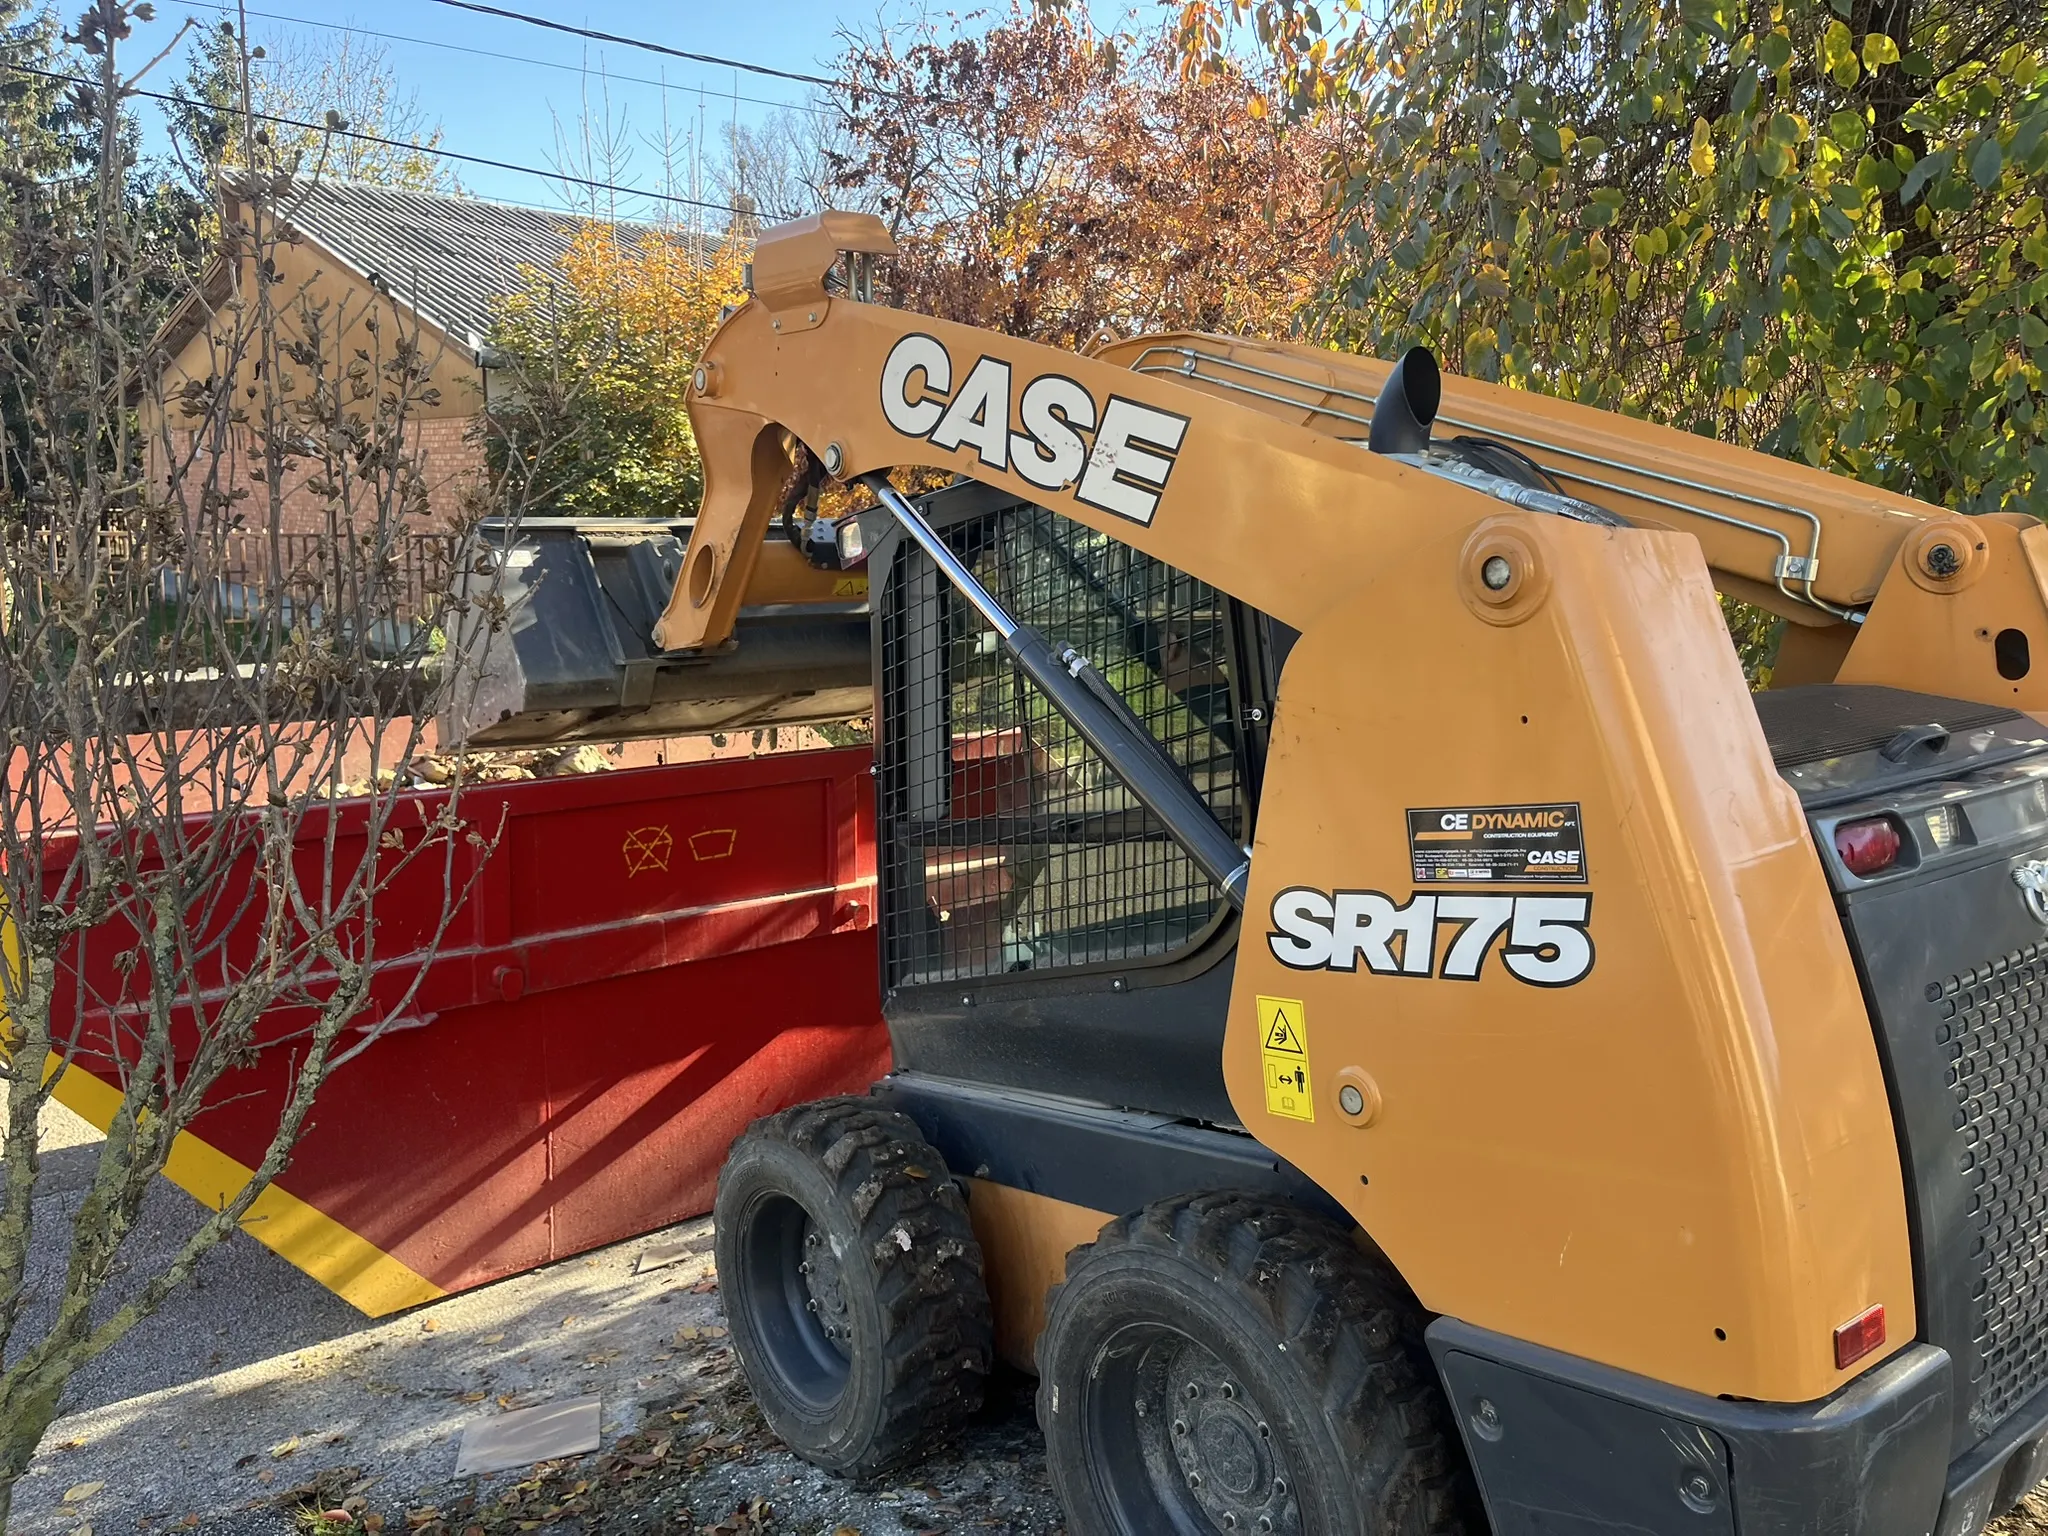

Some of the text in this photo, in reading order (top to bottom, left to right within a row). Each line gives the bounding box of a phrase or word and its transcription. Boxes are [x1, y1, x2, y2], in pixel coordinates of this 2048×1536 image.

[880, 332, 1192, 529] CASE
[1440, 814, 1468, 831] CE
[1472, 811, 1565, 830] DYNAMIC
[1527, 850, 1580, 865] CASE
[1266, 886, 1596, 988] SR175
